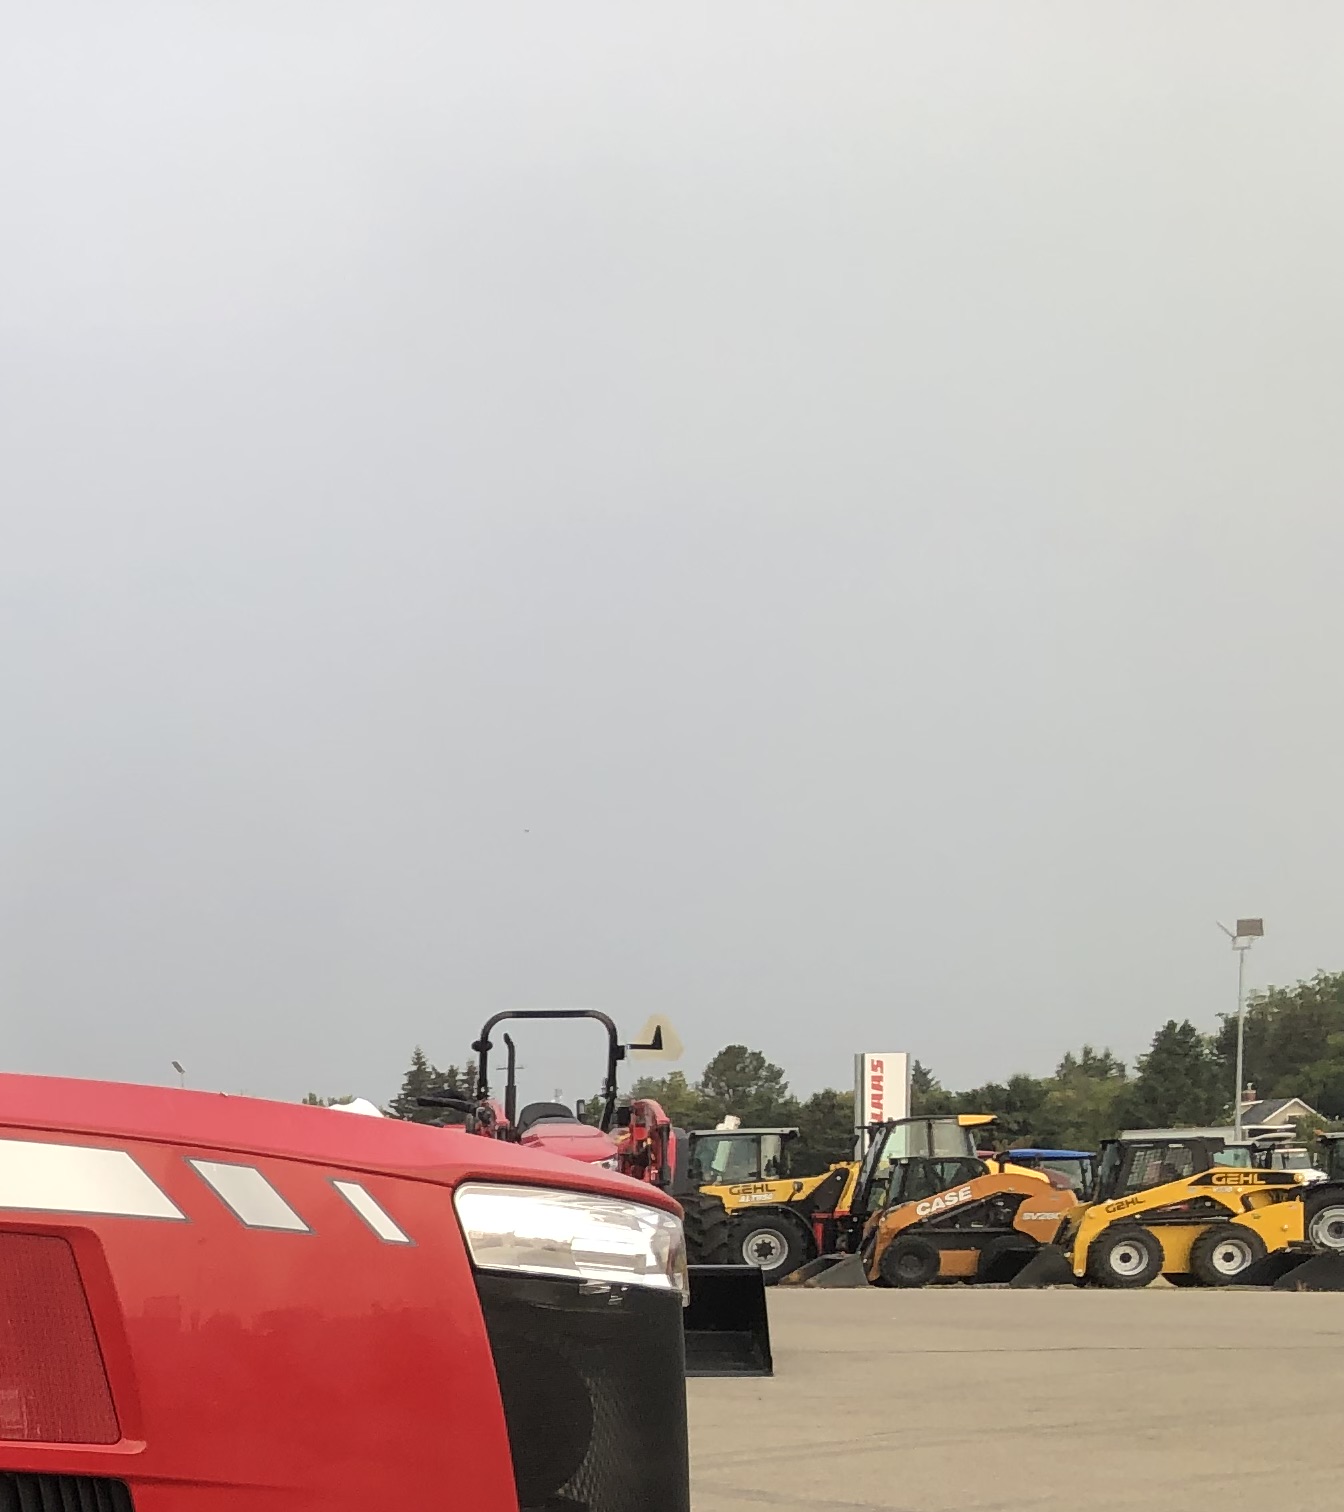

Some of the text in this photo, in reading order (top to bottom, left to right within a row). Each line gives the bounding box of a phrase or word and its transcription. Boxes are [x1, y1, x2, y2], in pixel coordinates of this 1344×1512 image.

[870, 1058, 884, 1123] LAAS
[1211, 1173, 1266, 1185] GEHL
[729, 1183, 776, 1196] GEHL
[916, 1185, 973, 1216] CASE
[1105, 1196, 1146, 1214] GEHL
